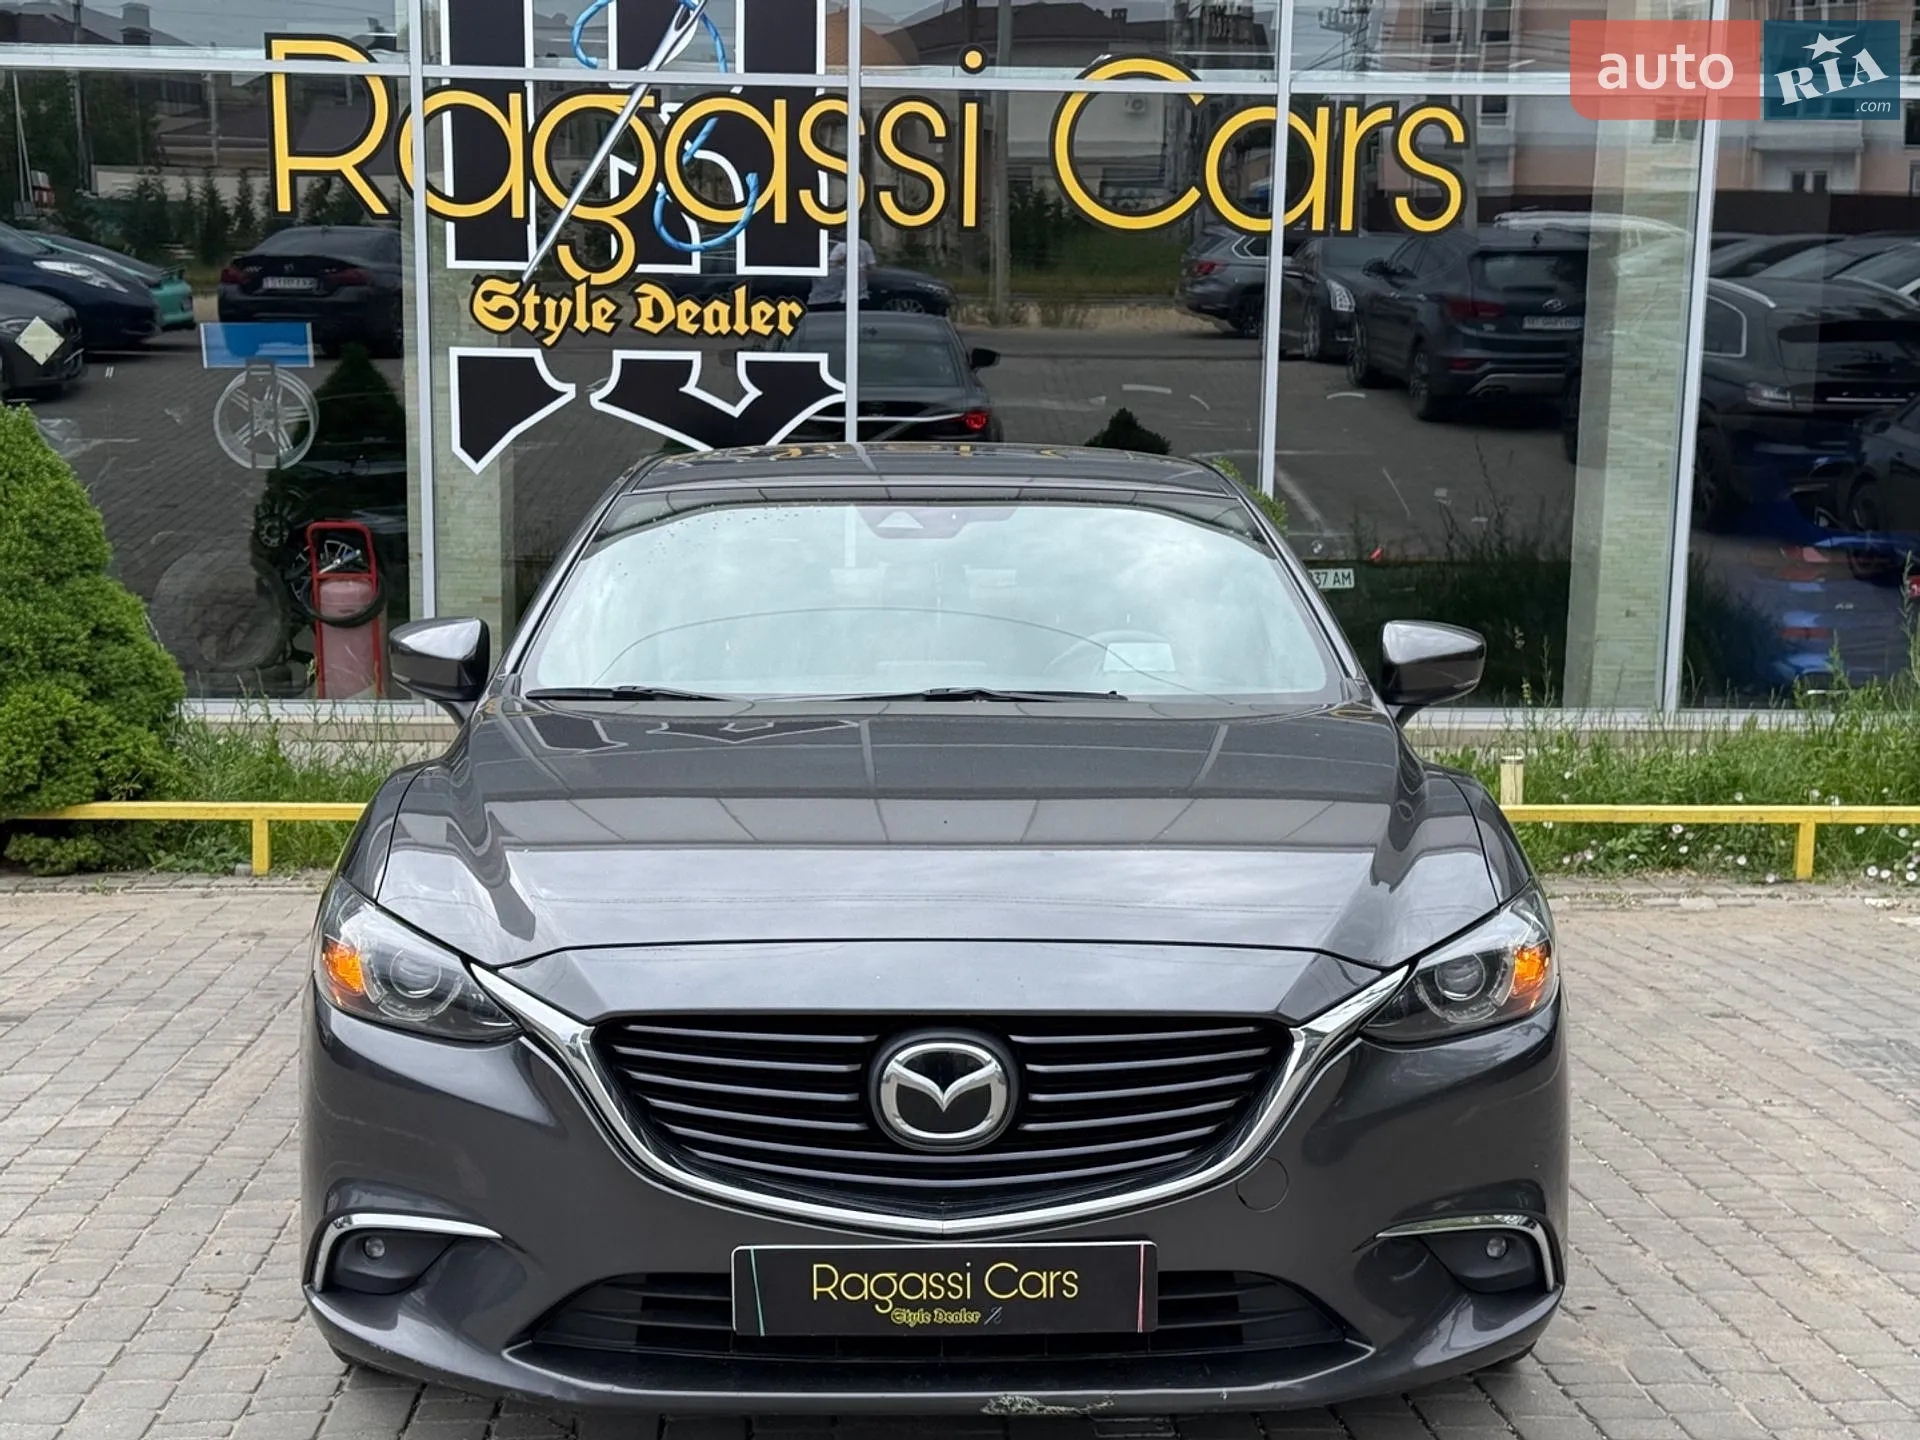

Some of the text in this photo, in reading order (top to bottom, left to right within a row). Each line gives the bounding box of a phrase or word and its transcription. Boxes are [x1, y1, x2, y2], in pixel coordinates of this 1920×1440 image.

[269, 37, 1466, 285] Ragassi Cars
[472, 278, 802, 347] Style Dealer
[1333, 571, 1352, 586] AM
[812, 1262, 1079, 1313] Ragassi Cars
[891, 1307, 982, 1327] Style Dealer
